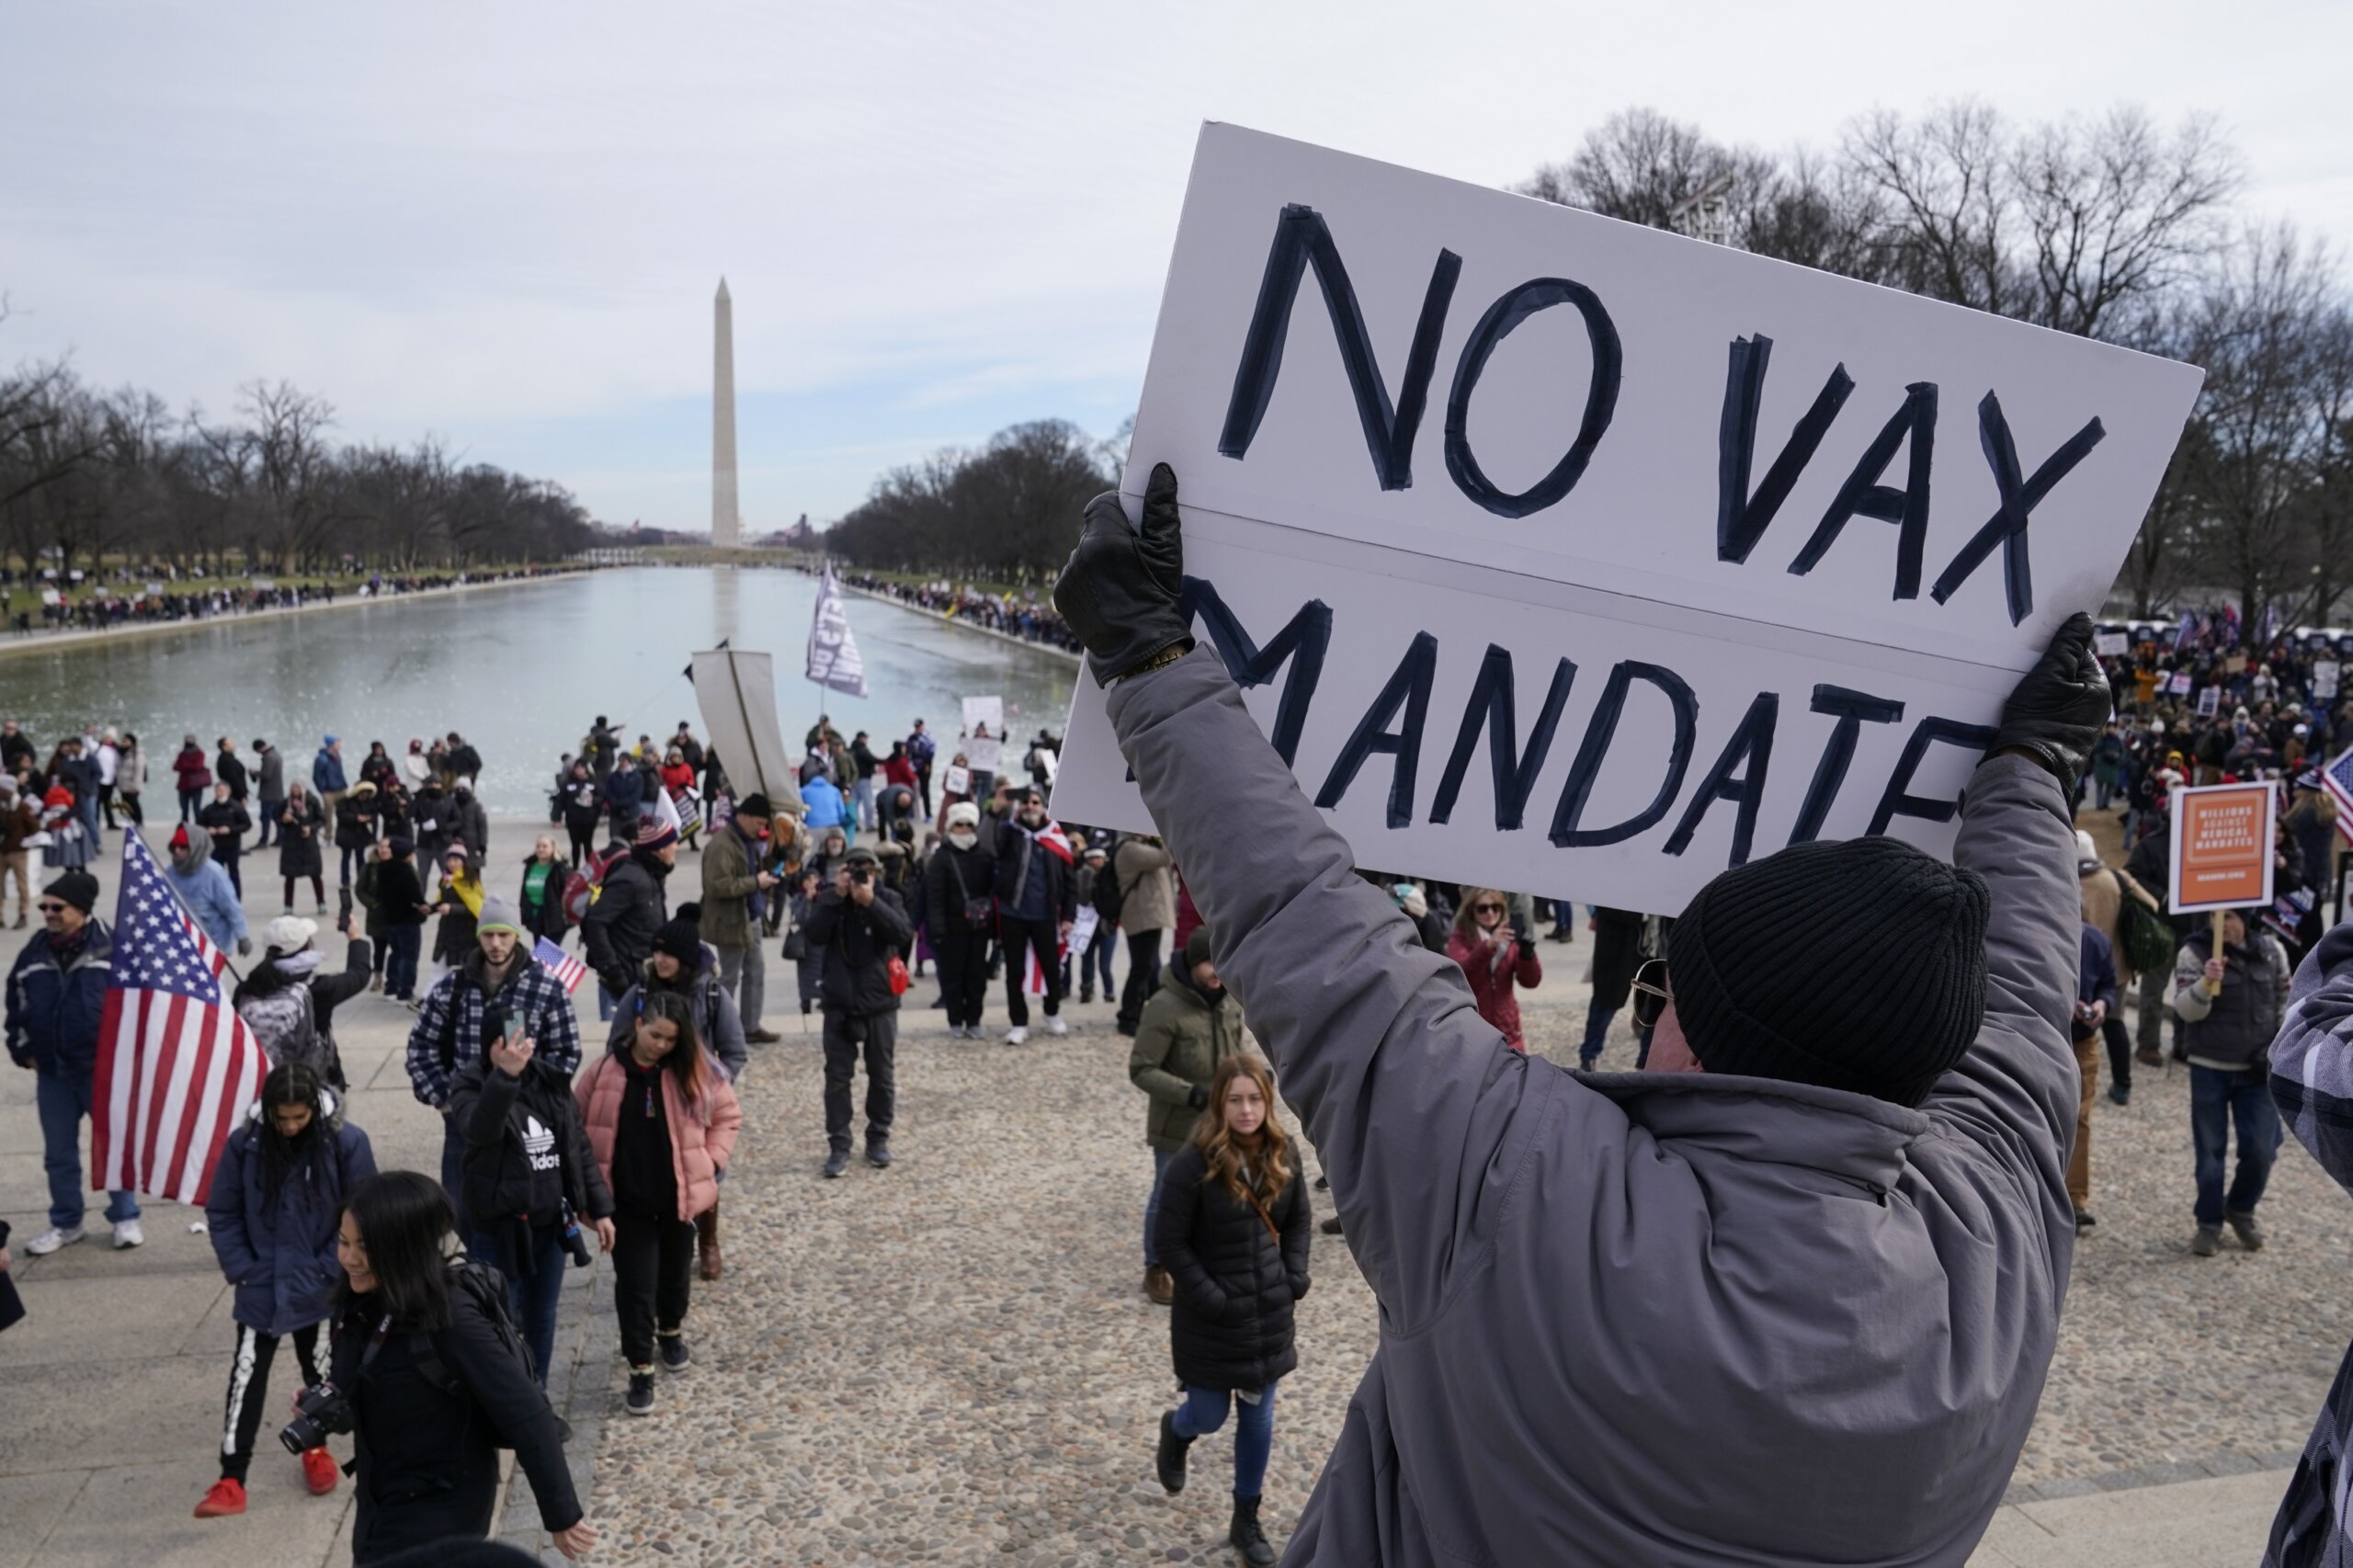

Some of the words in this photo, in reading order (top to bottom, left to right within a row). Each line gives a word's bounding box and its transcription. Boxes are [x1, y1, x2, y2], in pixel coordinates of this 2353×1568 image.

[1218, 203, 1622, 518] NO
[1717, 332, 2107, 627] VAX
[2200, 806, 2252, 819] MILLIONS
[2200, 827, 2248, 839] MEDICAL
